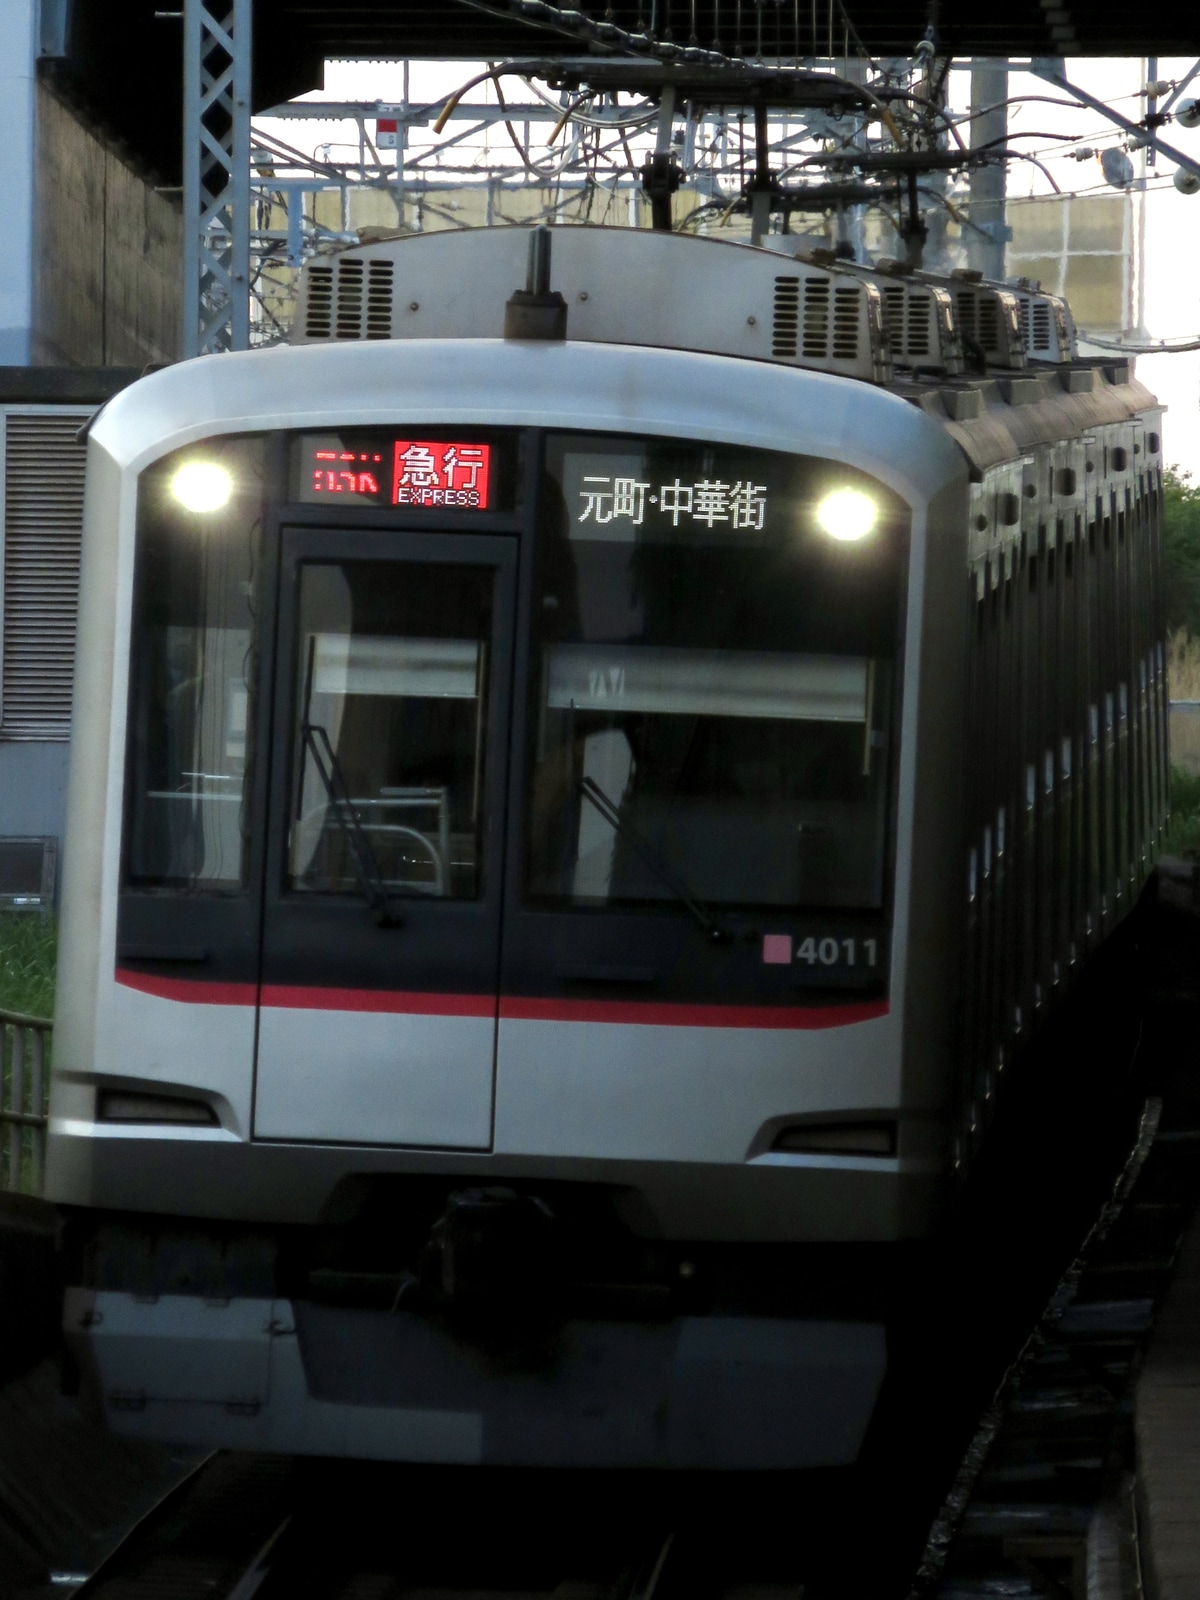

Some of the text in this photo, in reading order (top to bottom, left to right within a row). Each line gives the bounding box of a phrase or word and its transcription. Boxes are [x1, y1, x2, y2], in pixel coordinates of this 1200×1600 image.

[400, 445, 484, 488] 急行
[398, 487, 480, 506] EXPRESS
[796, 937, 877, 966] 4011
